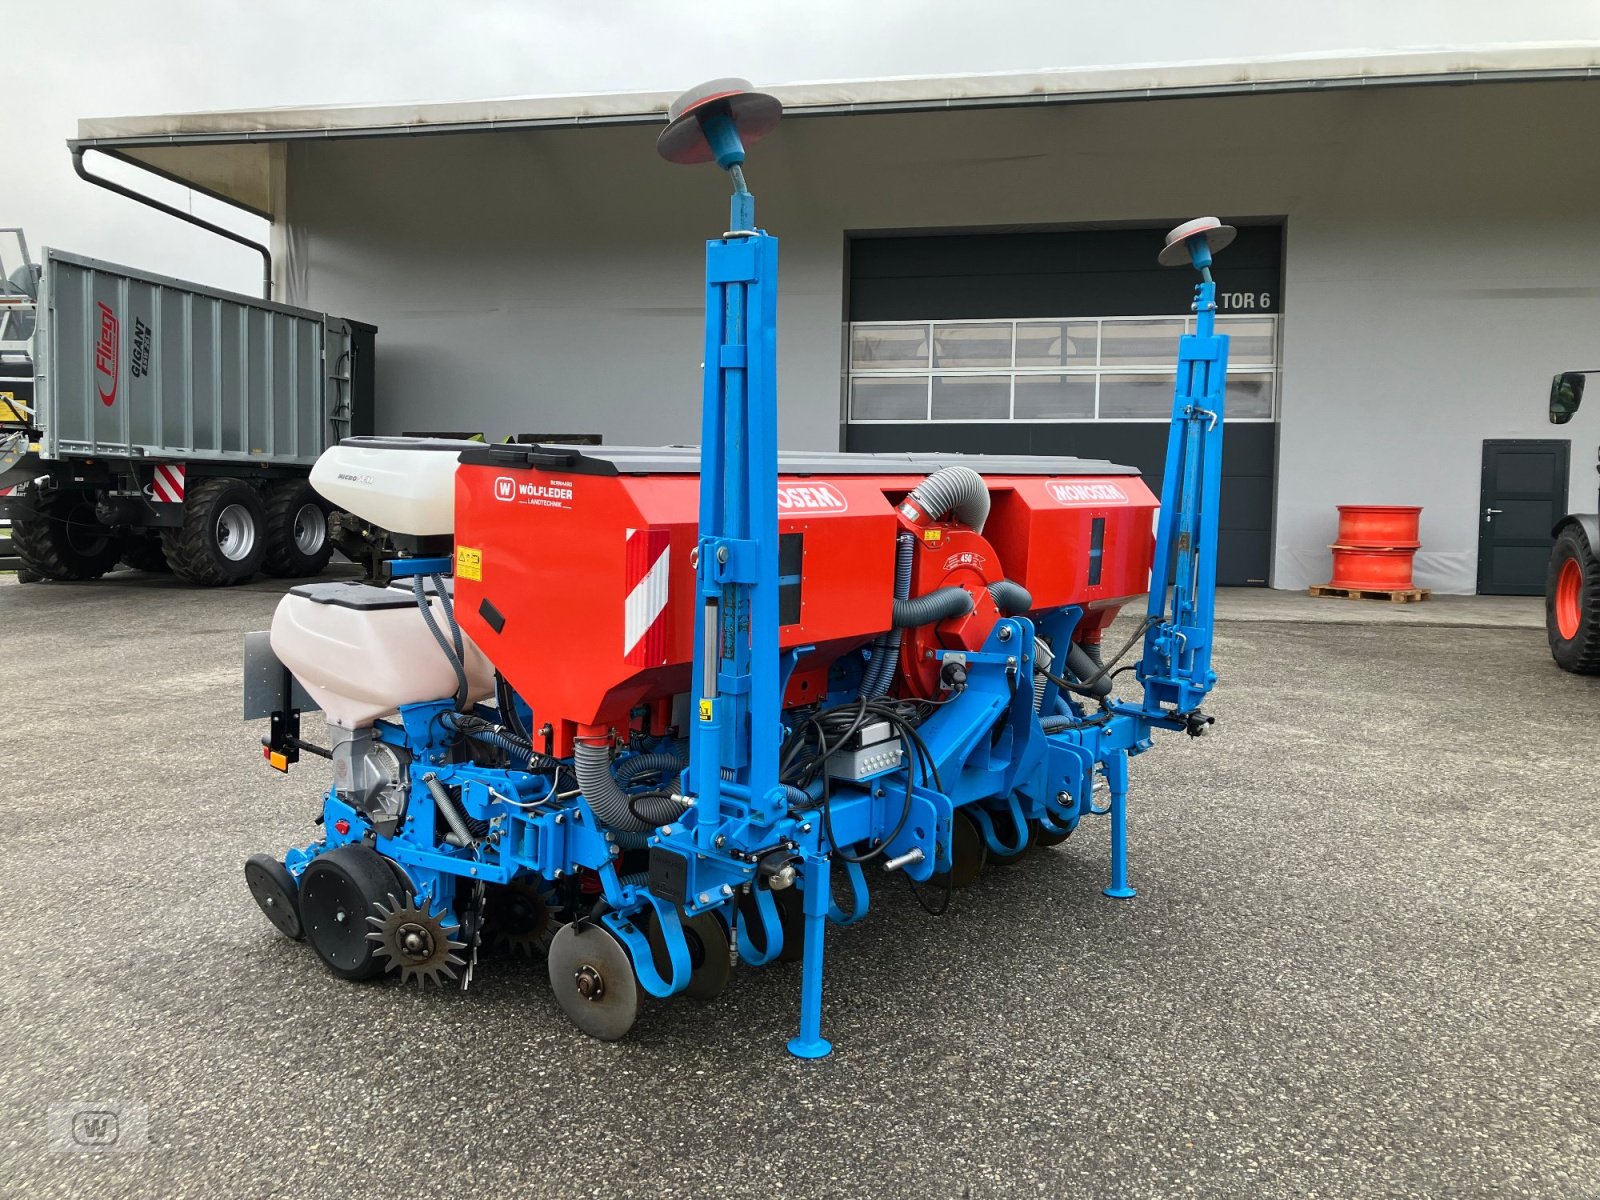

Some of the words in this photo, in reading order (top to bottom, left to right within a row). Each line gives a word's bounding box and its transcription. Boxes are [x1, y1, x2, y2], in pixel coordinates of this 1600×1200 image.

[1221, 292, 1255, 309] TOR
[1260, 292, 1271, 308] 6
[96, 301, 118, 376] Fliegl
[131, 316, 145, 378] GIGANT
[519, 483, 573, 500] WÖLFLEDER
[778, 487, 843, 509] OSEM
[1052, 485, 1126, 501] MONOSEM
[528, 498, 563, 508] LANDTECHNIK
[960, 553, 973, 563] 450
